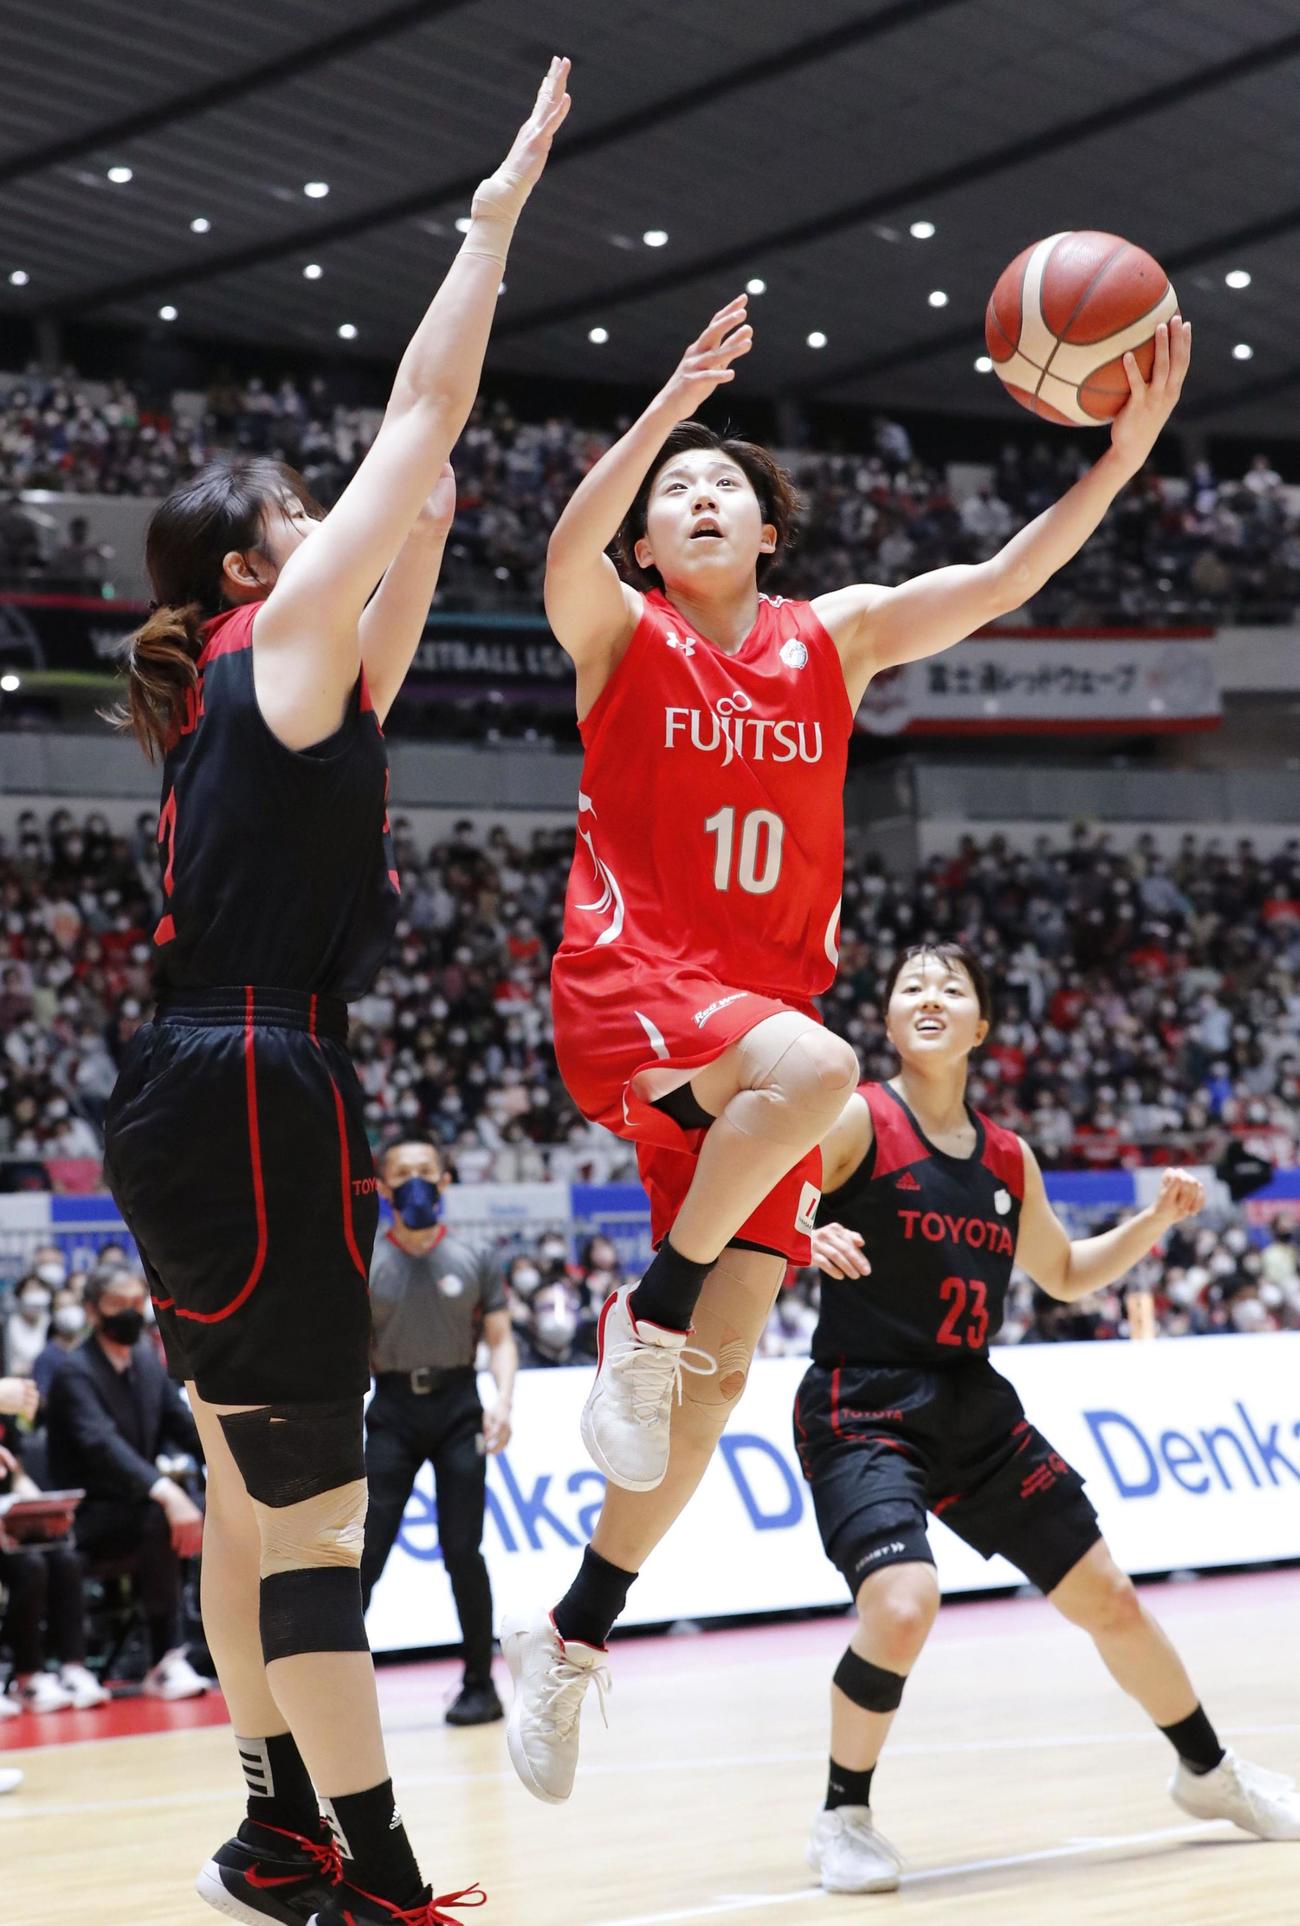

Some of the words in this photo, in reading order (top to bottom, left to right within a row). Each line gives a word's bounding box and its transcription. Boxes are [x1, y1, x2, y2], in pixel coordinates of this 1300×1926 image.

[664, 705, 823, 768] FUJITSU
[704, 805, 784, 895] 10
[352, 1177, 376, 1196] TOY
[897, 1208, 1014, 1258] TOYOTA
[936, 1275, 990, 1350] 23
[1082, 1400, 1300, 1499] Denk
